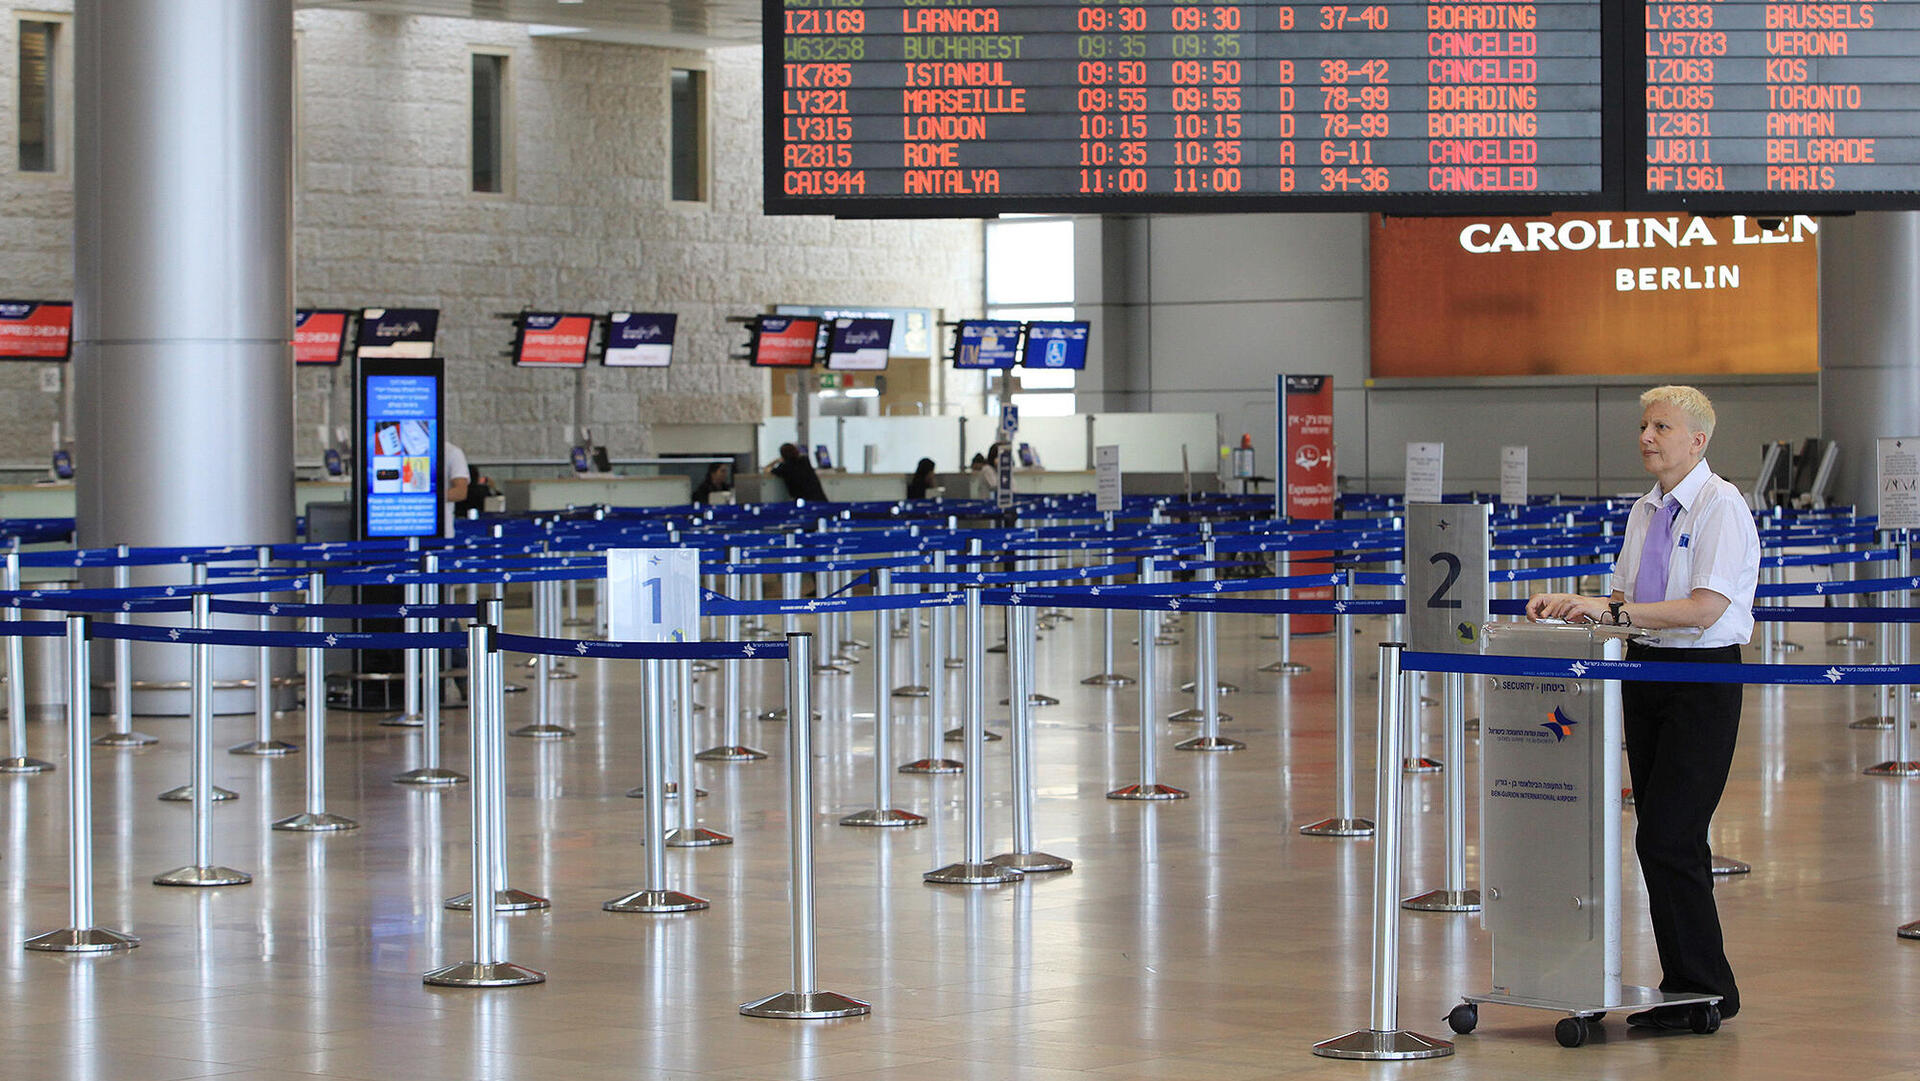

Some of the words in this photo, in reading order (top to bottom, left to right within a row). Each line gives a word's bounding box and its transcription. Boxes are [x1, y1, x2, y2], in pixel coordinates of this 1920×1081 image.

[785, 10, 865, 33] IZ1169
[903, 8, 999, 32] LARNACA
[1078, 8, 1146, 31] 09:30
[1172, 7, 1240, 30] 09:30
[1280, 7, 1294, 30] B
[1320, 6, 1388, 29] 37-40
[1428, 5, 1536, 29] BOARDING
[1646, 5, 1713, 28] LY333
[1766, 4, 1873, 28] BRUSSELS
[784, 37, 864, 60] W63258
[904, 36, 1024, 59] BUCHAREST
[1079, 35, 1146, 57] 09:35
[1173, 34, 1240, 57] 09:35
[1428, 32, 1537, 56] CANCELED
[1646, 32, 1727, 55] LY5783
[1767, 32, 1847, 55] VERONA
[784, 64, 852, 87] TK785
[905, 62, 1012, 86] ISTANBUL
[1078, 61, 1146, 84] 09:50
[1172, 61, 1241, 84] 09:50
[1280, 60, 1295, 83] B
[1321, 60, 1389, 83] 38-42
[1428, 59, 1537, 83] CANCELED
[1648, 59, 1713, 82] IZ063
[1767, 59, 1807, 82] KOS
[784, 90, 849, 114] LY321
[904, 89, 1026, 113] MARSEILLE
[1078, 88, 1147, 112] 09:55
[1172, 87, 1241, 111] 09:55
[1280, 87, 1295, 111] D
[1321, 86, 1389, 110] 78-99
[1428, 86, 1537, 110] BOARDING
[1767, 85, 1860, 109] TORONTO
[784, 117, 852, 140] LY315
[904, 116, 985, 140] LONDON
[1080, 115, 1147, 139] 10:15
[1174, 114, 1241, 138] 10:15
[1280, 114, 1295, 137] D
[1321, 113, 1389, 137] 78-99
[1428, 112, 1537, 137] BOARDING
[1648, 113, 1711, 136] IZ961
[1767, 112, 1834, 136] AMMAN
[784, 144, 852, 167] AZ815
[904, 143, 959, 166] ROME
[1080, 142, 1147, 165] 10:35
[1175, 141, 1241, 164] 10:35
[1280, 141, 1295, 164] A
[1321, 141, 1373, 164] 6-11
[1429, 140, 1537, 164] CANCELED
[1647, 140, 1710, 163] JU811
[1767, 139, 1875, 163] BELGRADE
[904, 170, 999, 193] ANTALYA
[1080, 169, 1147, 192] 11:00
[1174, 168, 1241, 192] 11:00
[1280, 168, 1295, 191] B
[1321, 167, 1389, 191] 34-36
[1429, 167, 1537, 190] CANCELED
[1647, 166, 1725, 190] AF1961
[1767, 166, 1835, 189] PARIS
[1459, 217, 1717, 253] CAROLINA
[1615, 265, 1740, 291] BERLIN
[1427, 552, 1462, 608] 2
[641, 577, 662, 624] 1
[1502, 681, 1535, 691] SECURITY
[1541, 682, 1566, 694] ביטחון
